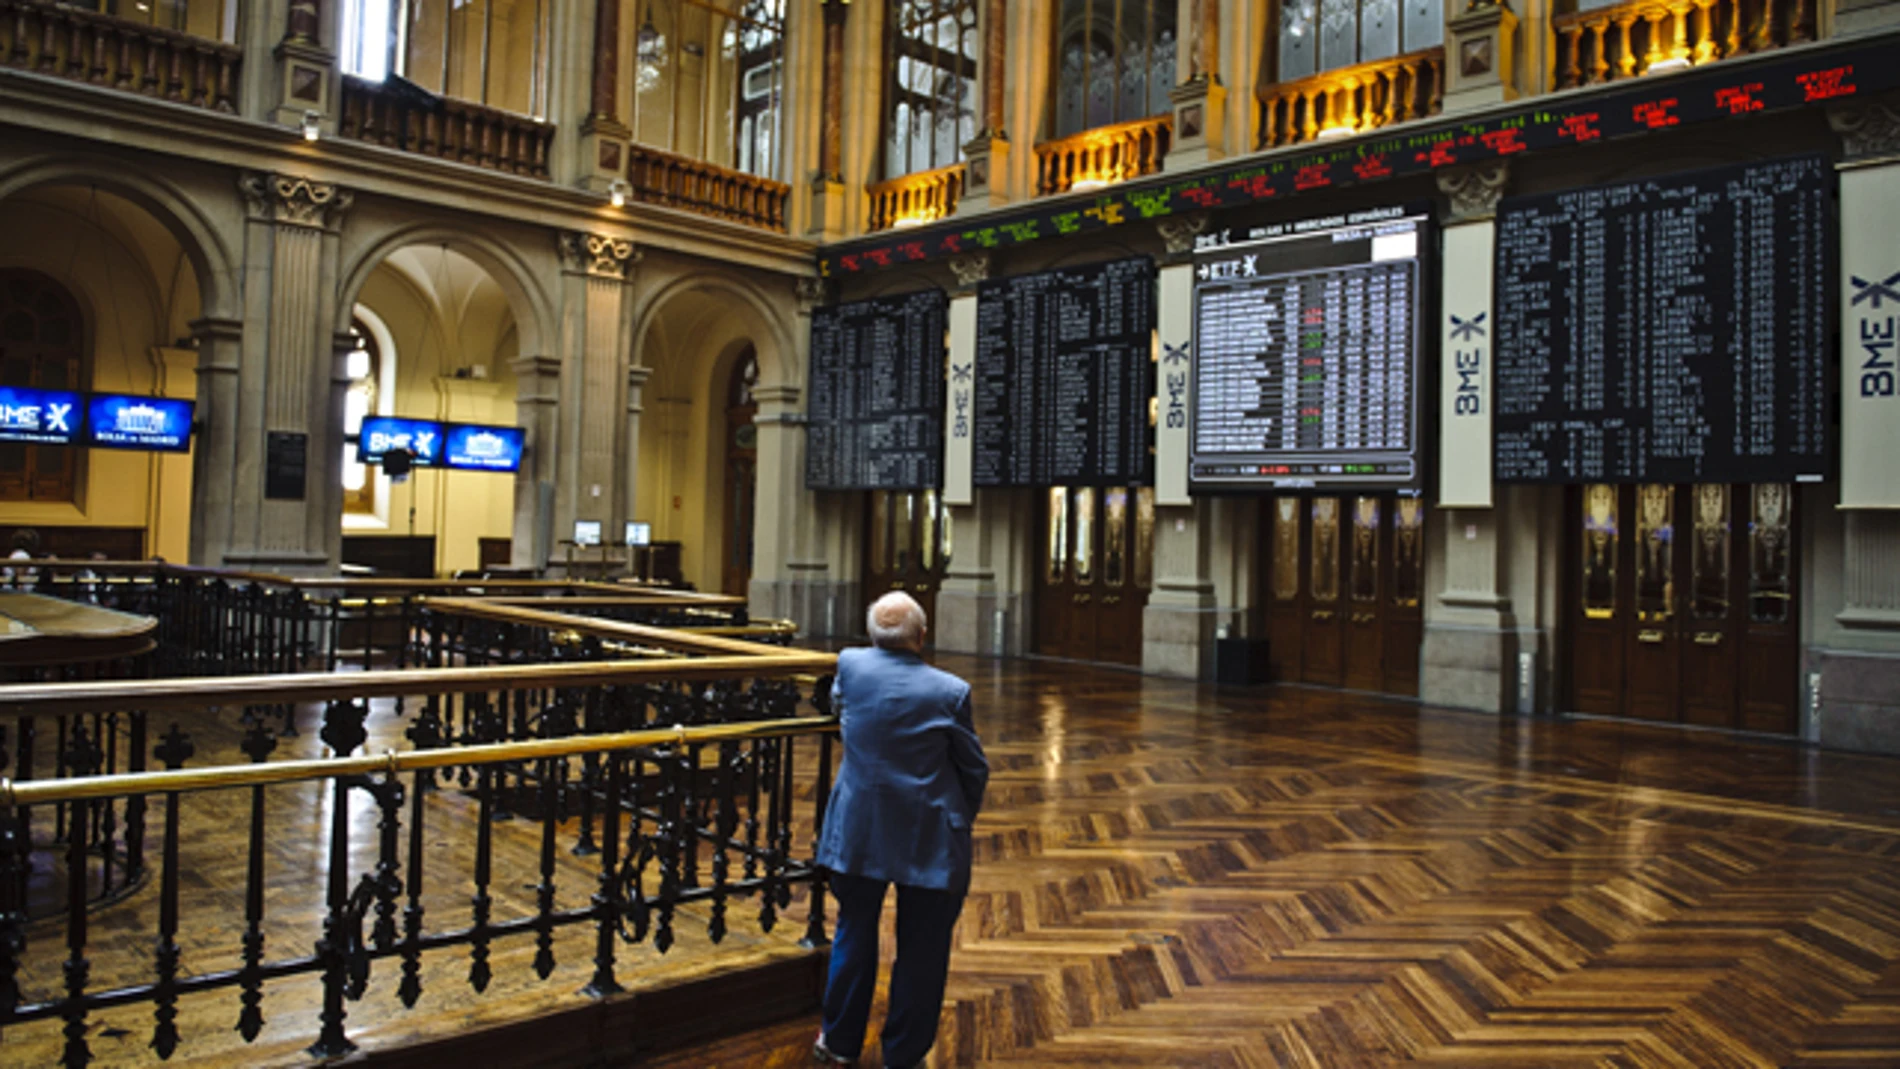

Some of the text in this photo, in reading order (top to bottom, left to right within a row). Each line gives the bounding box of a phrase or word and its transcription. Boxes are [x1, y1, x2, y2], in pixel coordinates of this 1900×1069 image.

[1455, 348, 1480, 416] BME
[1860, 316, 1895, 397] BME
[0, 405, 42, 424] ME
[953, 389, 968, 438] BME
[1167, 371, 1185, 428] BME
